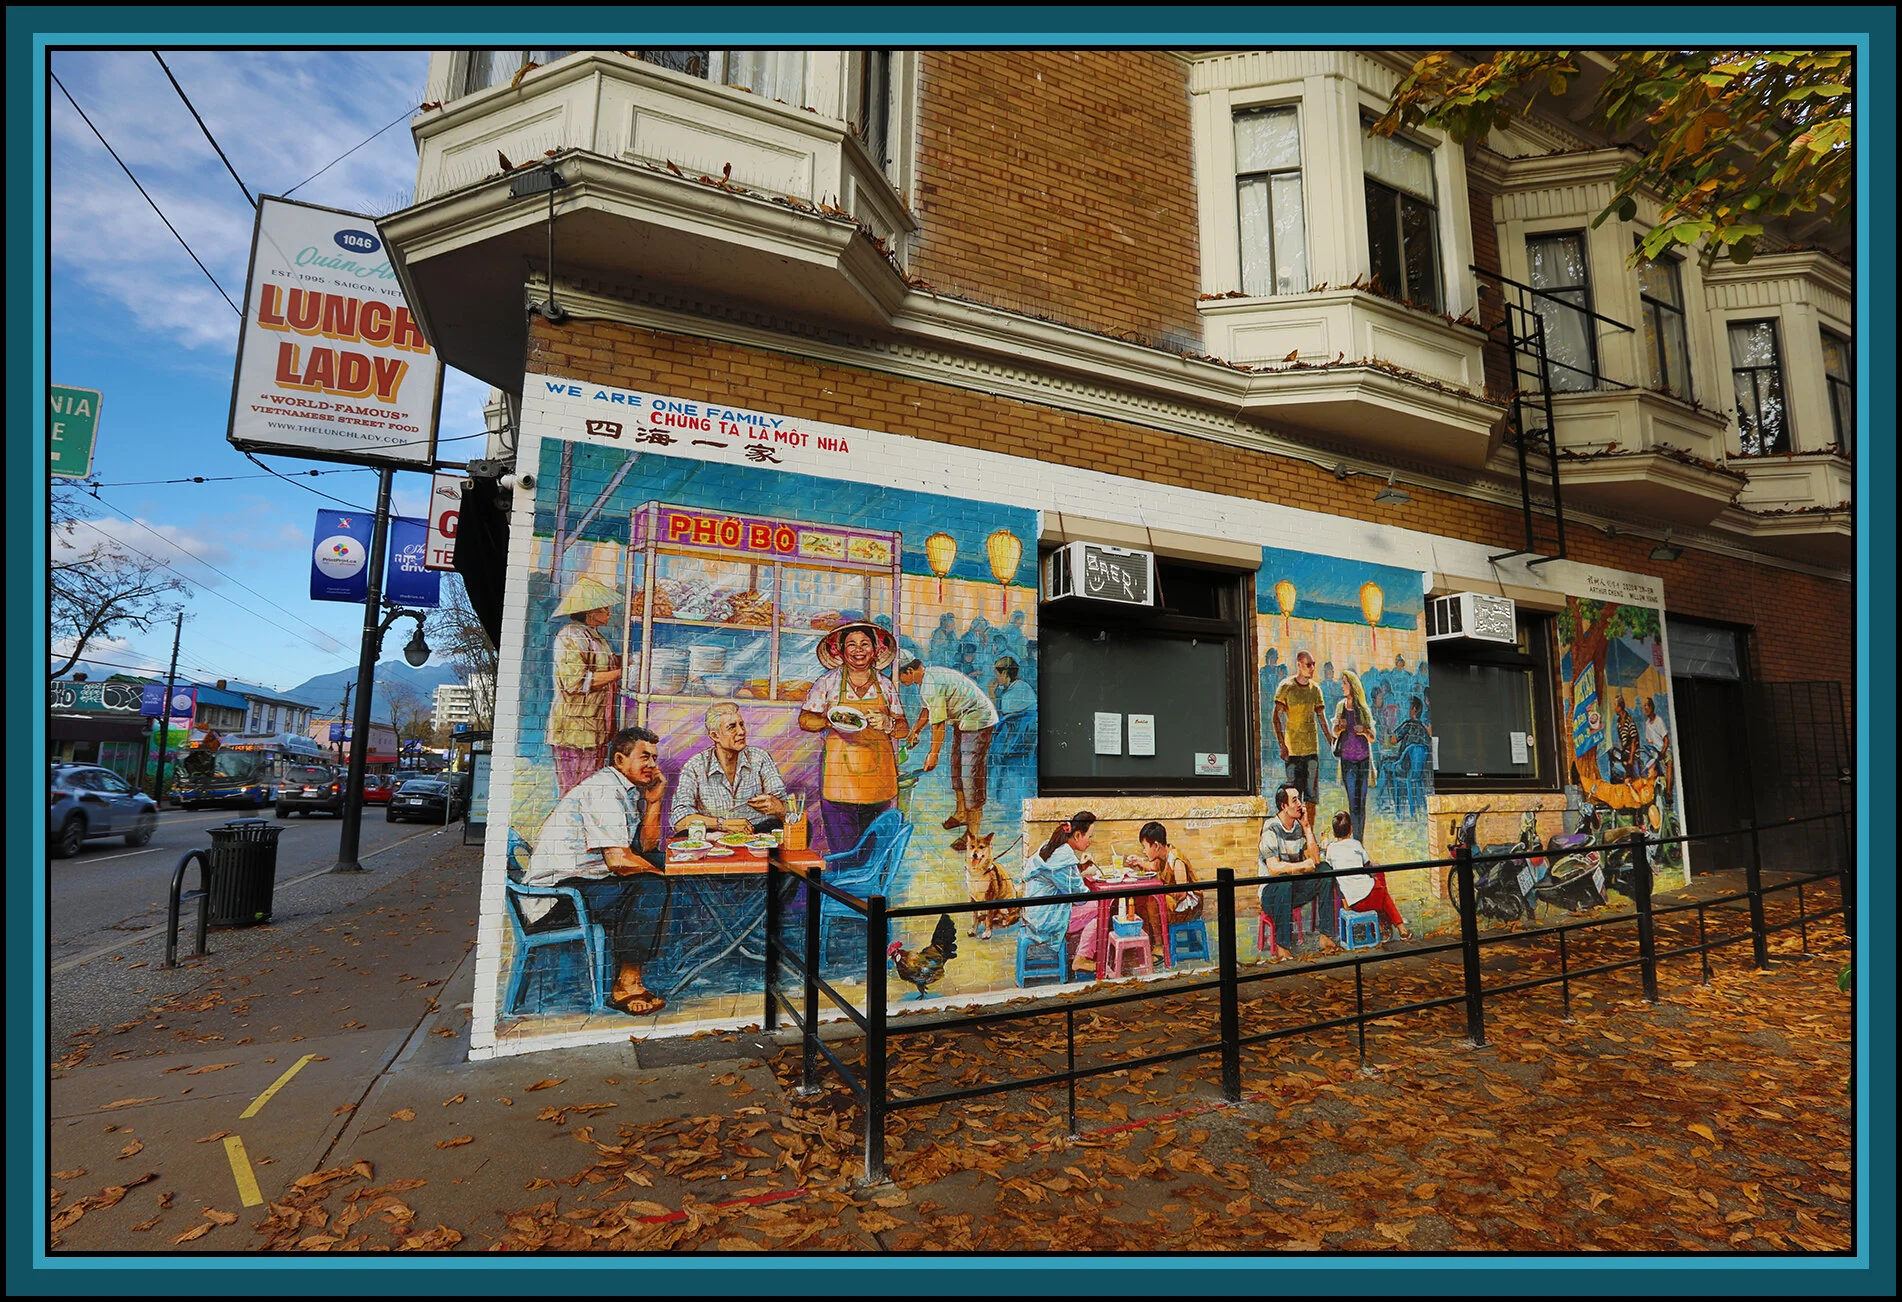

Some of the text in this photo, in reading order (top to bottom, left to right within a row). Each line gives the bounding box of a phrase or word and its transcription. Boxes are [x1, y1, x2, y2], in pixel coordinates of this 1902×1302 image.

[343, 234, 373, 249] 1046
[271, 269, 294, 279] EST.
[299, 273, 326, 284] 1995
[334, 279, 378, 294] SAIGON,
[256, 283, 430, 355] LUNCH
[274, 341, 409, 404] LADY
[251, 404, 420, 434] VIETNAMESE STREET FOOD
[545, 381, 784, 430] WE ARE ONE FAMILY
[268, 421, 408, 445] WWW.THELUNCHLADY.COM
[585, 418, 785, 465] 四海一家
[718, 421, 740, 437] TA
[748, 425, 770, 441] LÀ
[773, 428, 810, 450] MỘT
[817, 436, 850, 454] NHÀ
[749, 522, 797, 553] BÒ
